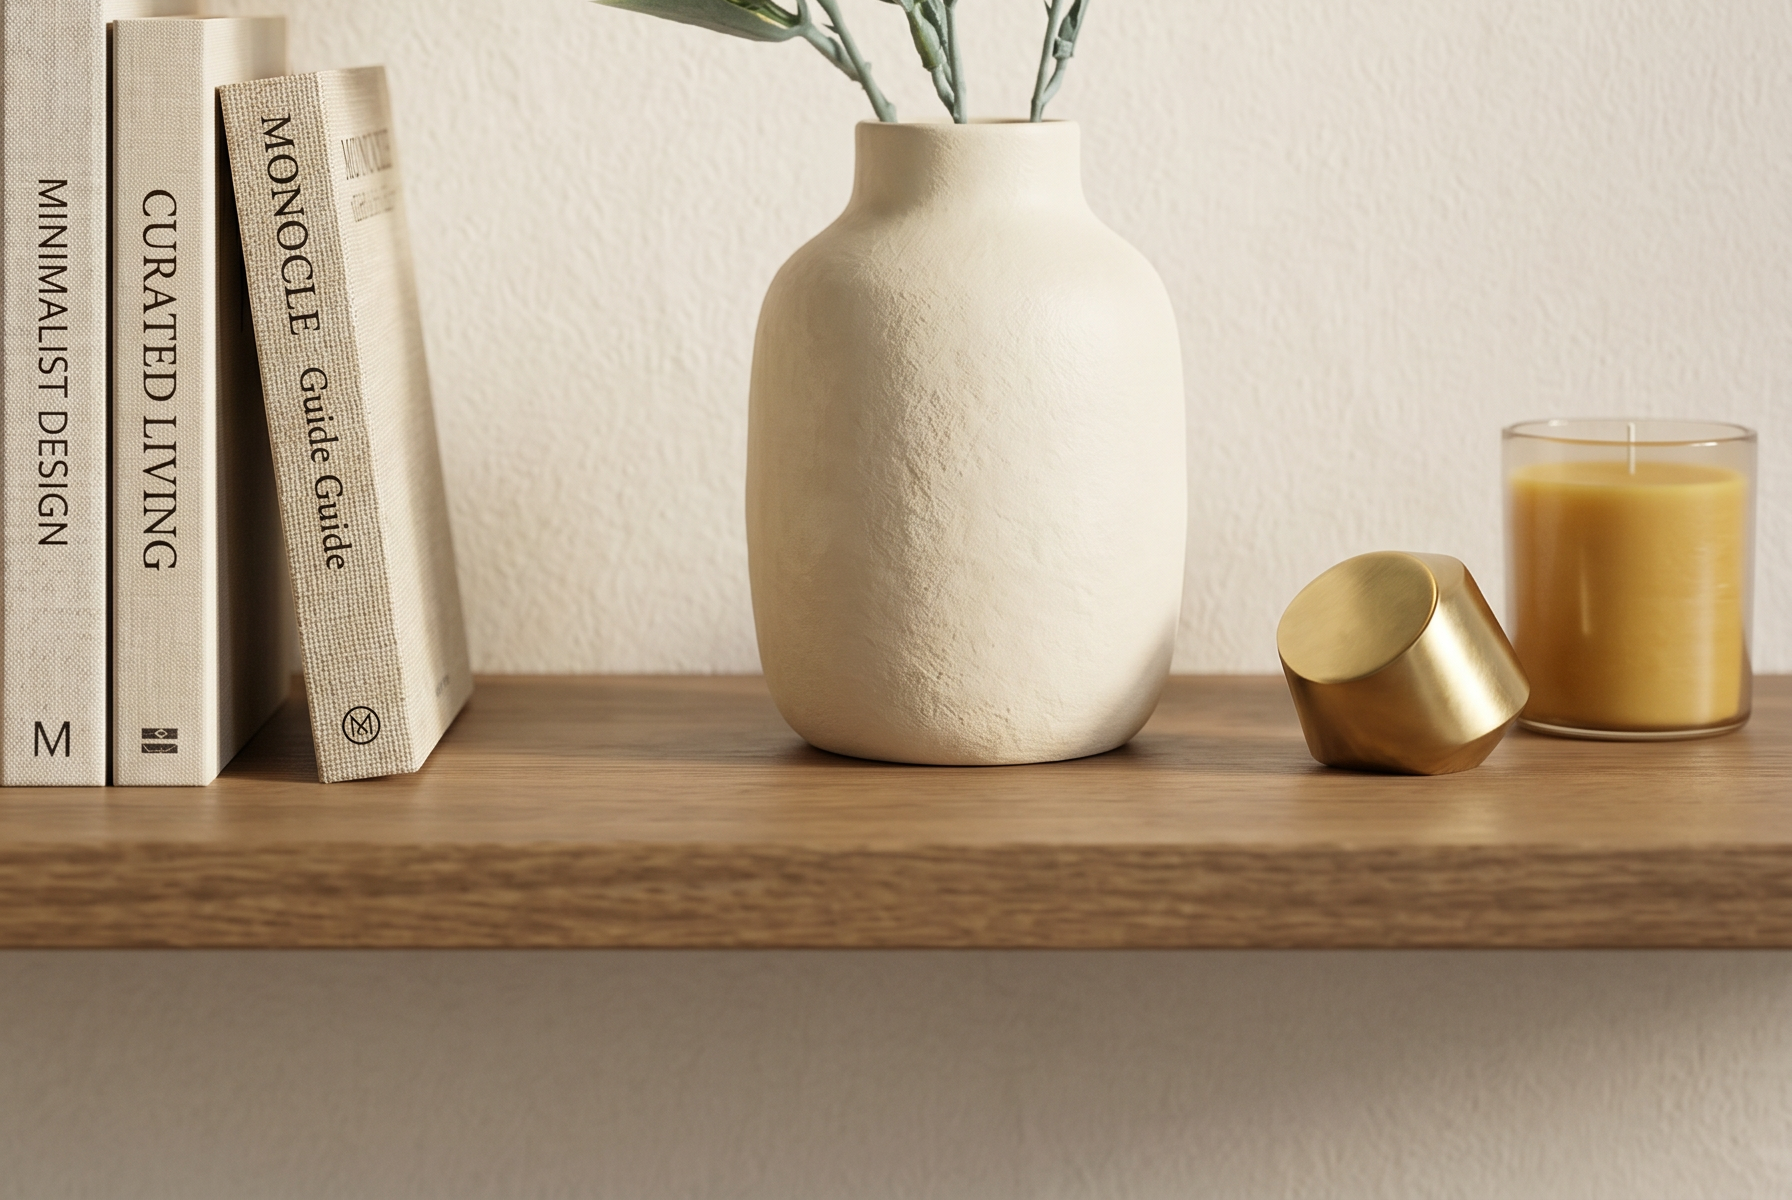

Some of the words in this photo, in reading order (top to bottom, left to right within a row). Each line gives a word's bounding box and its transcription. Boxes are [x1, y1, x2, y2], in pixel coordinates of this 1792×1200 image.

[38, 179, 69, 399] MINIMALIST
[142, 189, 177, 401] CURATED
[260, 112, 321, 336] MONOCLE
[38, 411, 69, 545] DESIGN
[299, 367, 339, 463] Guide
[142, 415, 178, 571] LIVING
[314, 474, 353, 570] Guide
[34, 720, 71, 758] M
